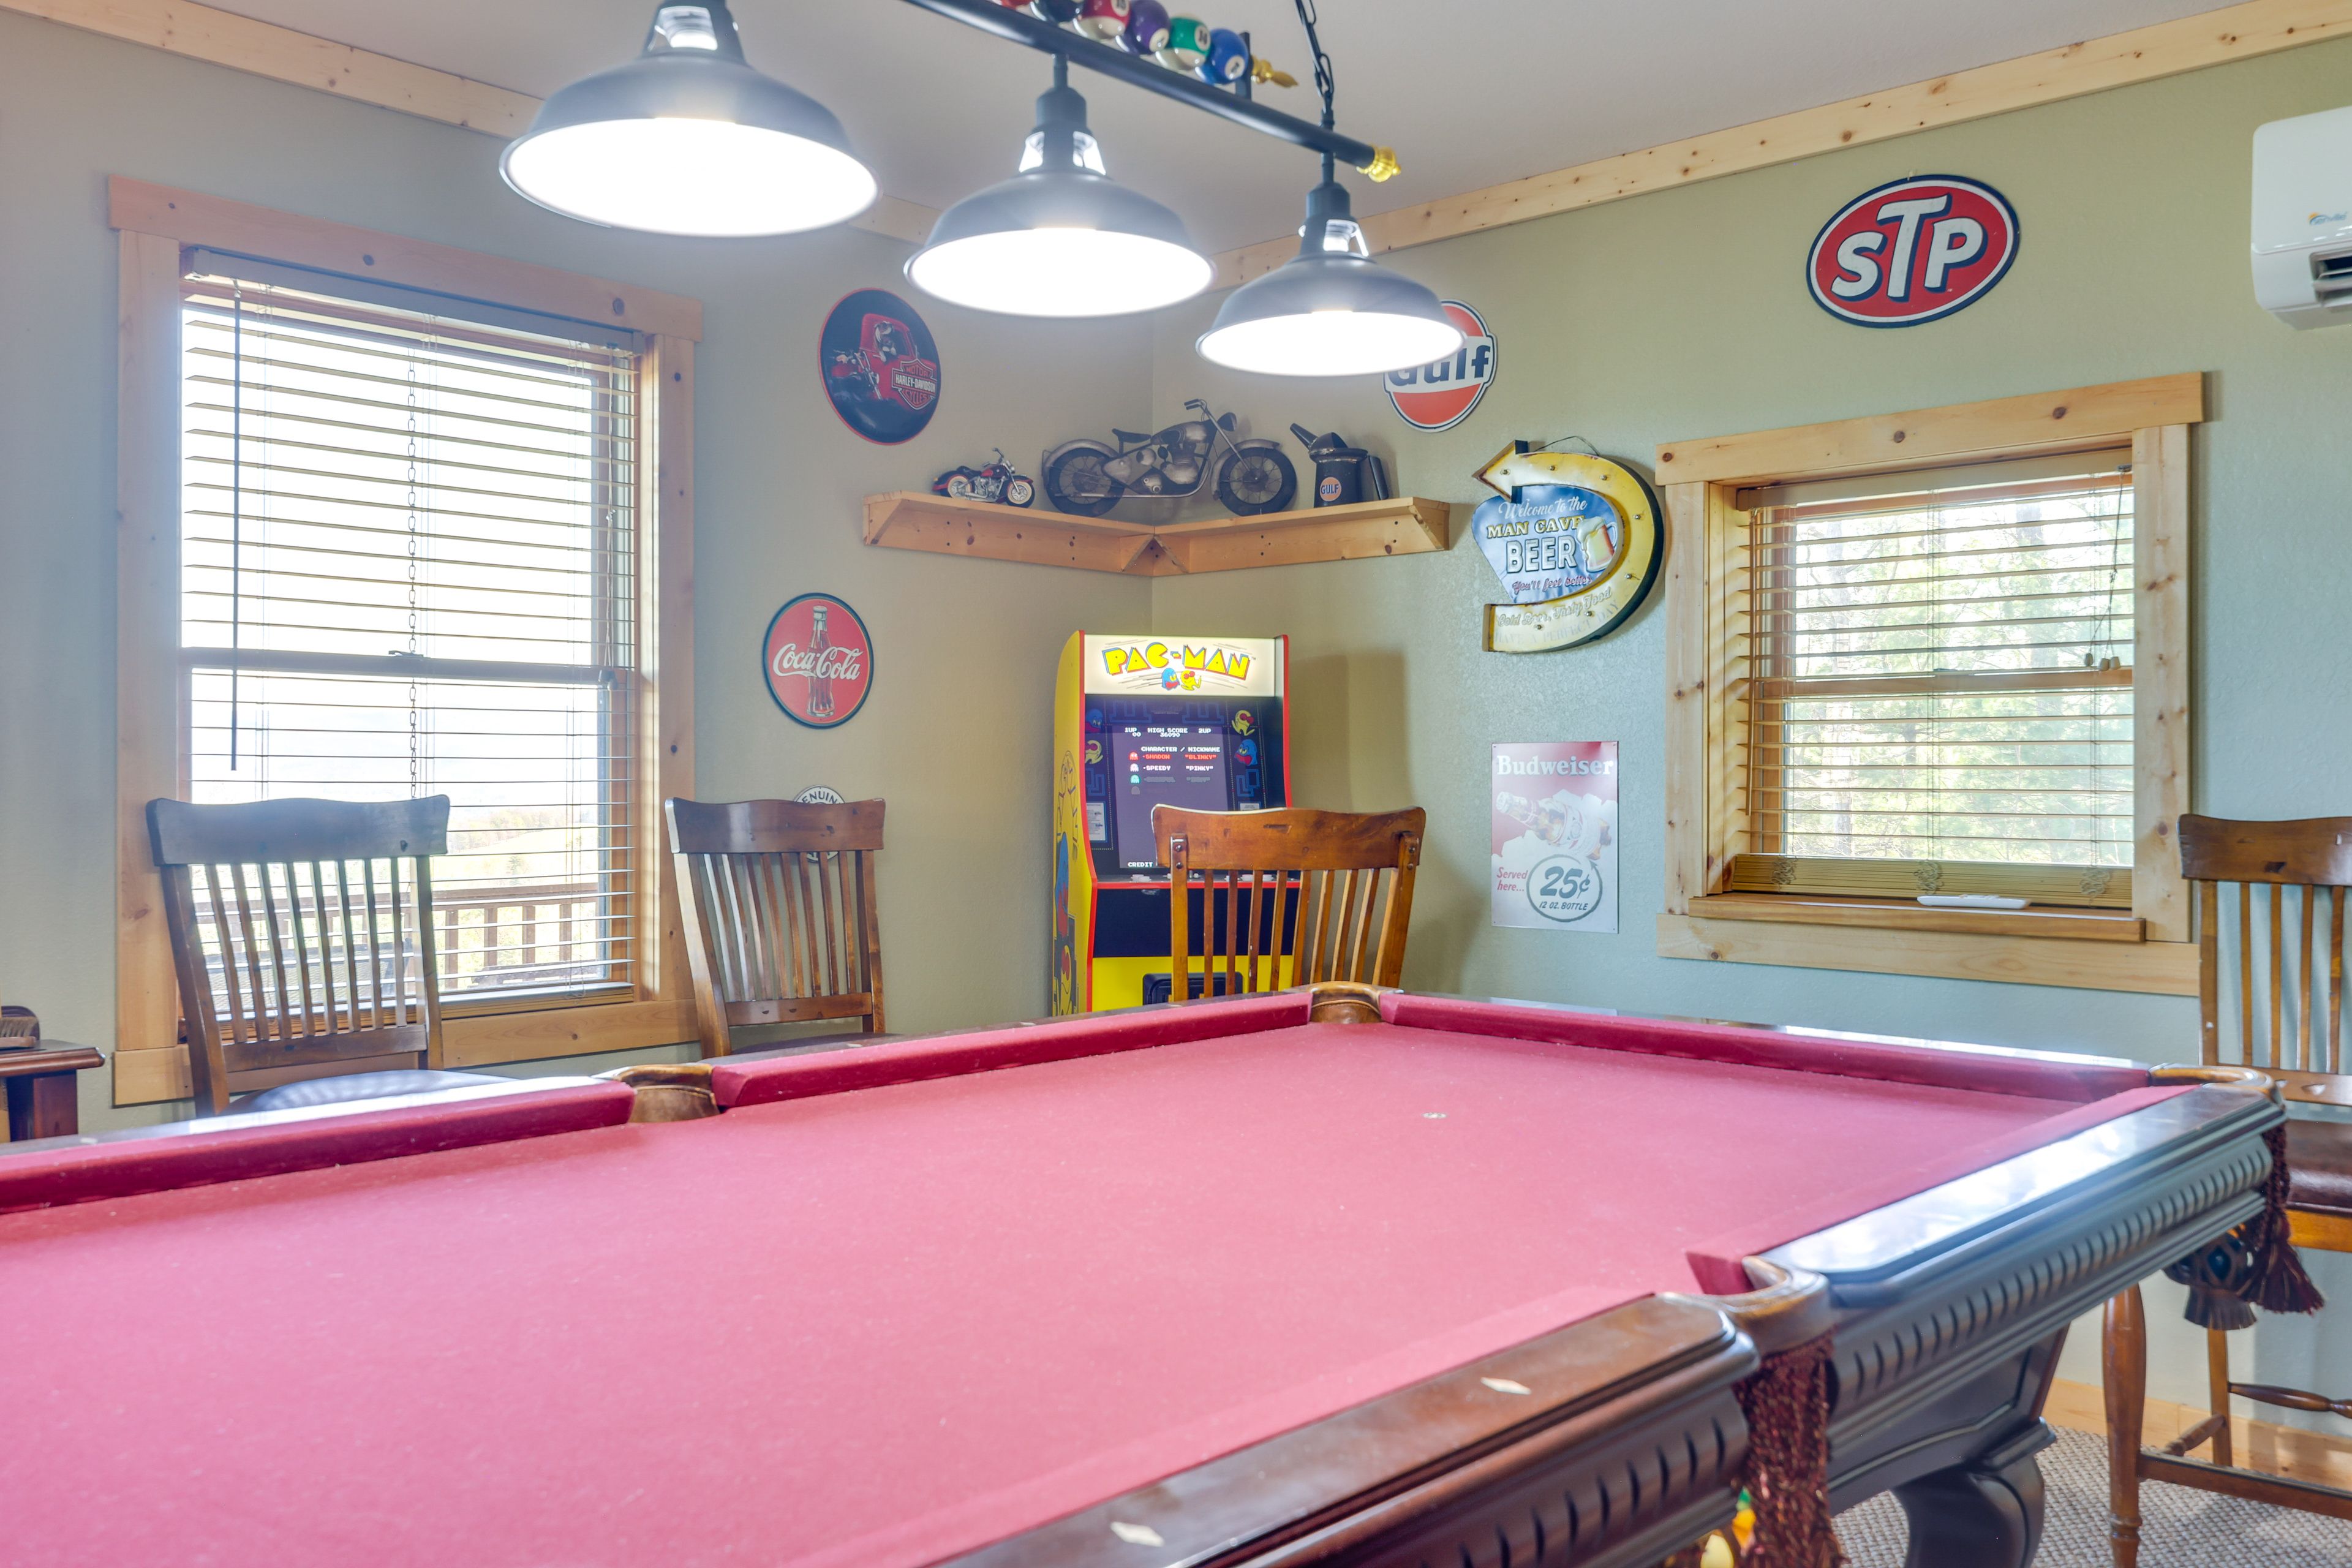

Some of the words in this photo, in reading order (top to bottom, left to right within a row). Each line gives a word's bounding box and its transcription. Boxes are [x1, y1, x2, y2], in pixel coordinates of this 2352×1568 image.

[1830, 193, 1988, 301] STP
[905, 364, 929, 377] MOTOR
[895, 374, 936, 393] HARLEY-DAVIDSON
[905, 390, 928, 404] CYCLES
[1321, 484, 1339, 494] GULF
[1498, 499, 1554, 519] Welcome
[1555, 498, 1568, 513] to
[1567, 496, 1588, 511] the
[1487, 521, 1529, 538] MAN
[1534, 515, 1586, 534] CAVE
[1506, 535, 1578, 574] BEER
[1498, 613, 1521, 627] Cold
[1583, 586, 1613, 610] Food
[772, 643, 864, 680] Coca-Cola
[1102, 642, 1250, 680] PAC-MAN
[1496, 755, 1615, 777] Budweiser
[802, 790, 841, 804] ENUIN
[1496, 867, 1529, 880] Served
[1539, 866, 1591, 899] 25¢
[1497, 880, 1525, 892] here...
[1561, 902, 1589, 911] BOTTLE
